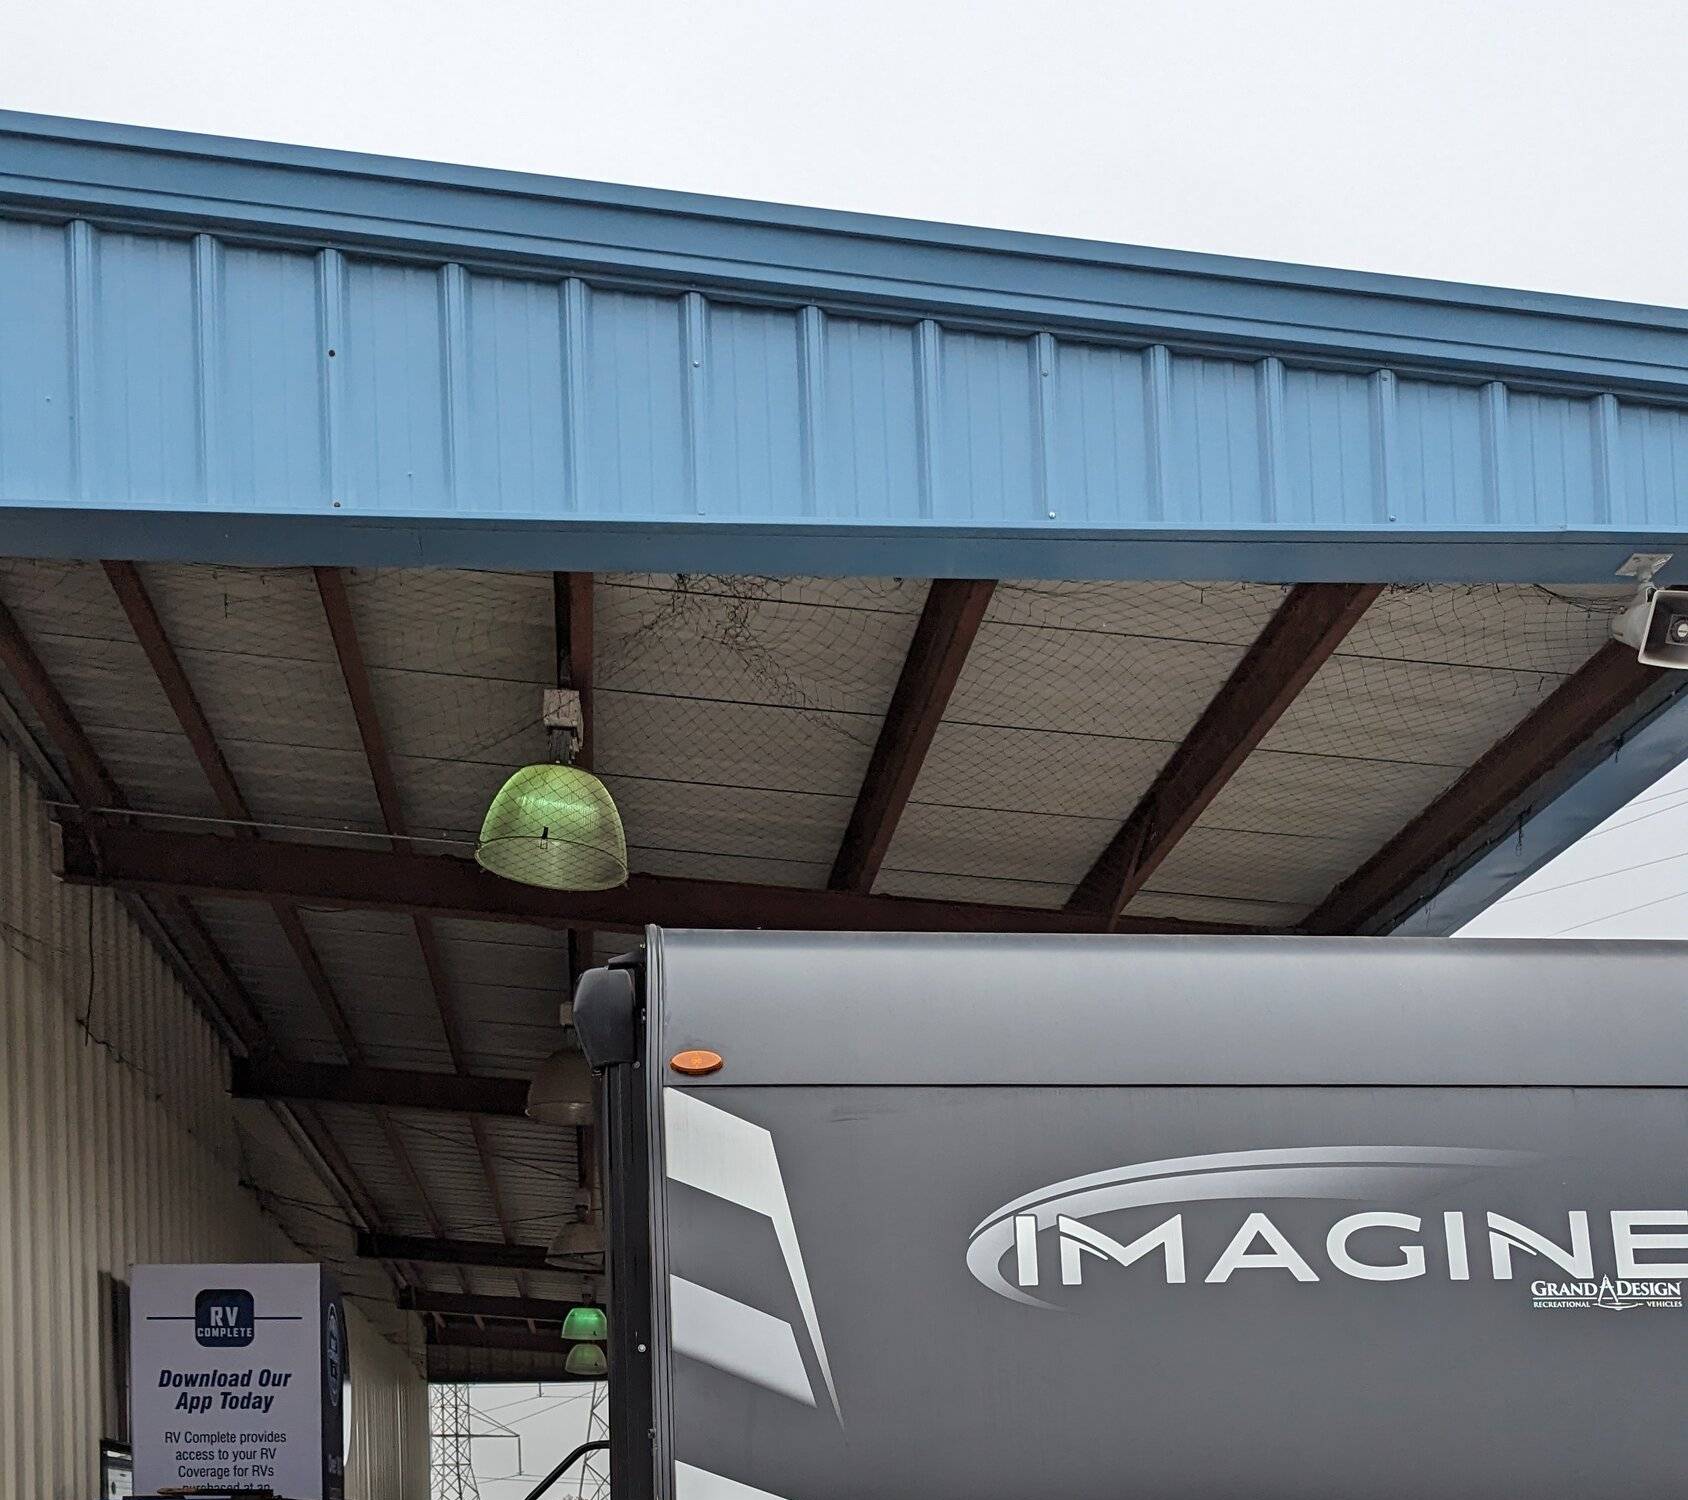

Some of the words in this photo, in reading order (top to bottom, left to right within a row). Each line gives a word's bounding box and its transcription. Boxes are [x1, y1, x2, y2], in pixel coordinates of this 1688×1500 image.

[1014, 1210, 1688, 1286] IMAGINE
[1530, 1280, 1598, 1296] GRAND
[1615, 1280, 1682, 1296] DESIGN
[1646, 1300, 1683, 1308] VEHICLES
[210, 1306, 239, 1327] RV
[197, 1327, 253, 1338] COMPLETE
[158, 1369, 252, 1388] Download
[258, 1368, 292, 1387] Our
[175, 1391, 213, 1414] App
[220, 1391, 274, 1414] Today
[164, 1432, 181, 1444] RV
[184, 1431, 237, 1446] Complete
[239, 1431, 287, 1445] provides
[175, 1451, 215, 1461] access
[218, 1449, 229, 1460] to
[232, 1451, 257, 1464] your
[260, 1448, 277, 1459] RV
[178, 1465, 230, 1480] Coverage
[233, 1464, 249, 1476] for
[252, 1464, 274, 1477] RVs
